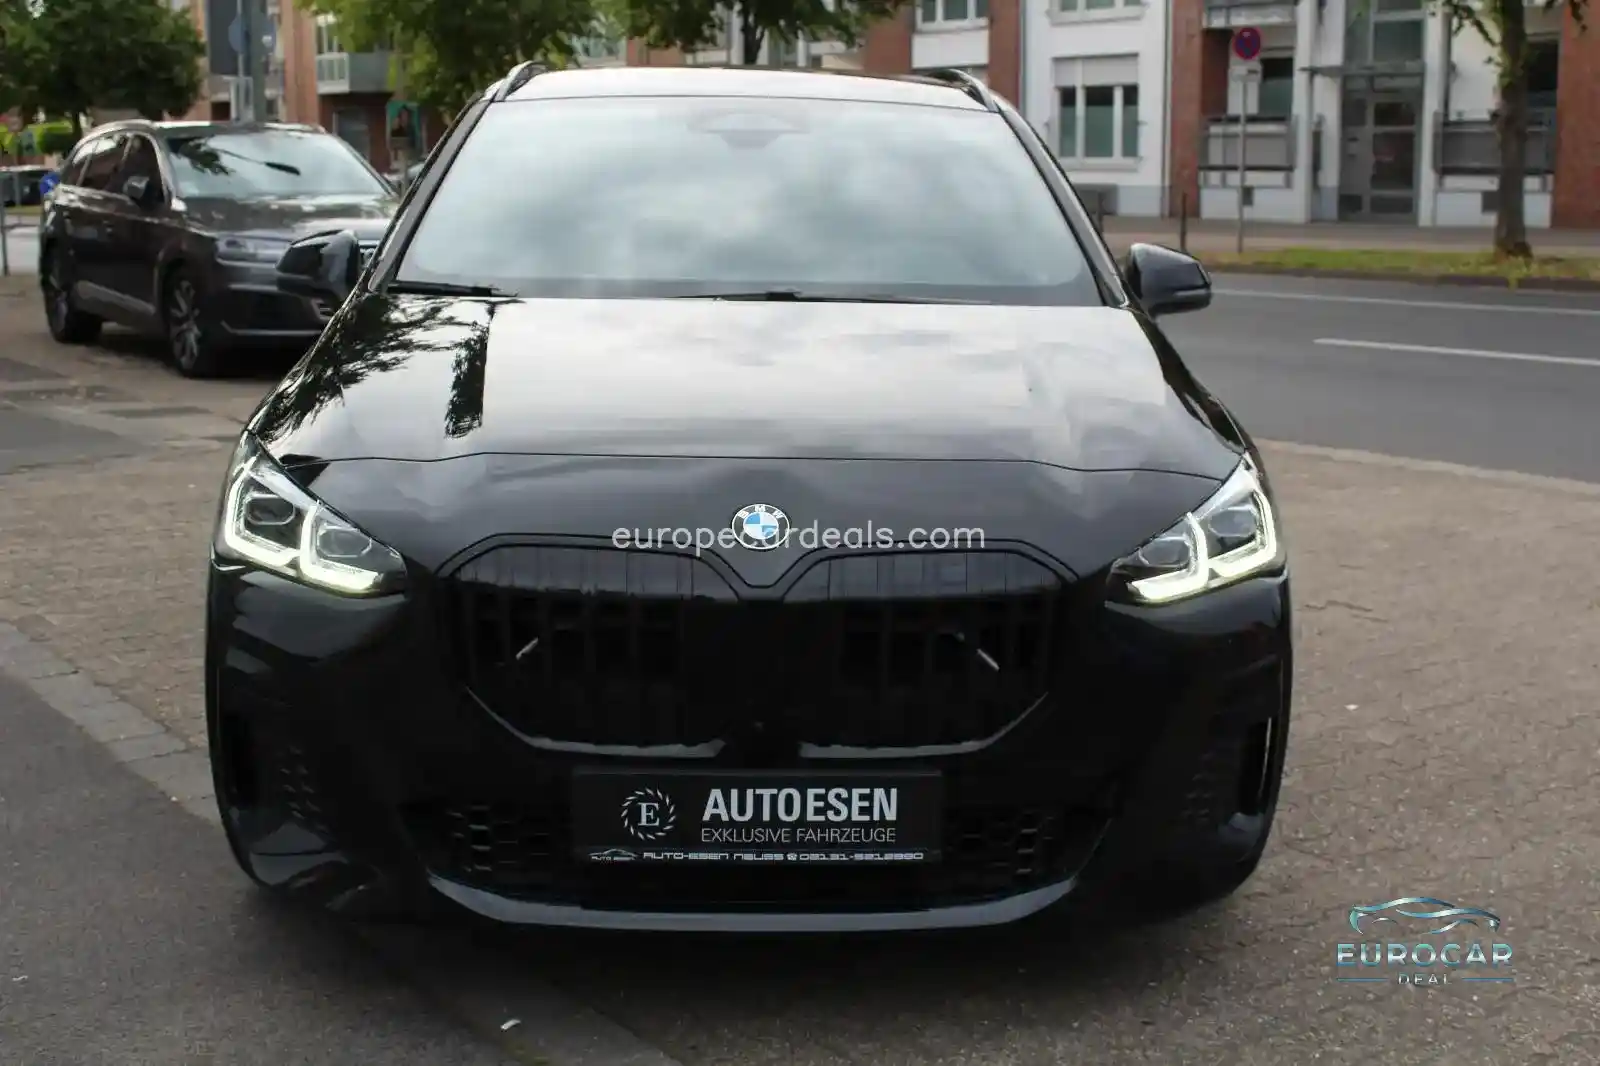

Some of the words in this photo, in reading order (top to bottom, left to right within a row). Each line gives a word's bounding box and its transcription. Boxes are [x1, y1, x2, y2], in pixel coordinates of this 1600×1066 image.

[737, 504, 785, 519] BMW
[637, 802, 660, 826] E
[701, 828, 791, 843] EXKLUSIVE
[796, 828, 897, 843] FAHRZEUGE
